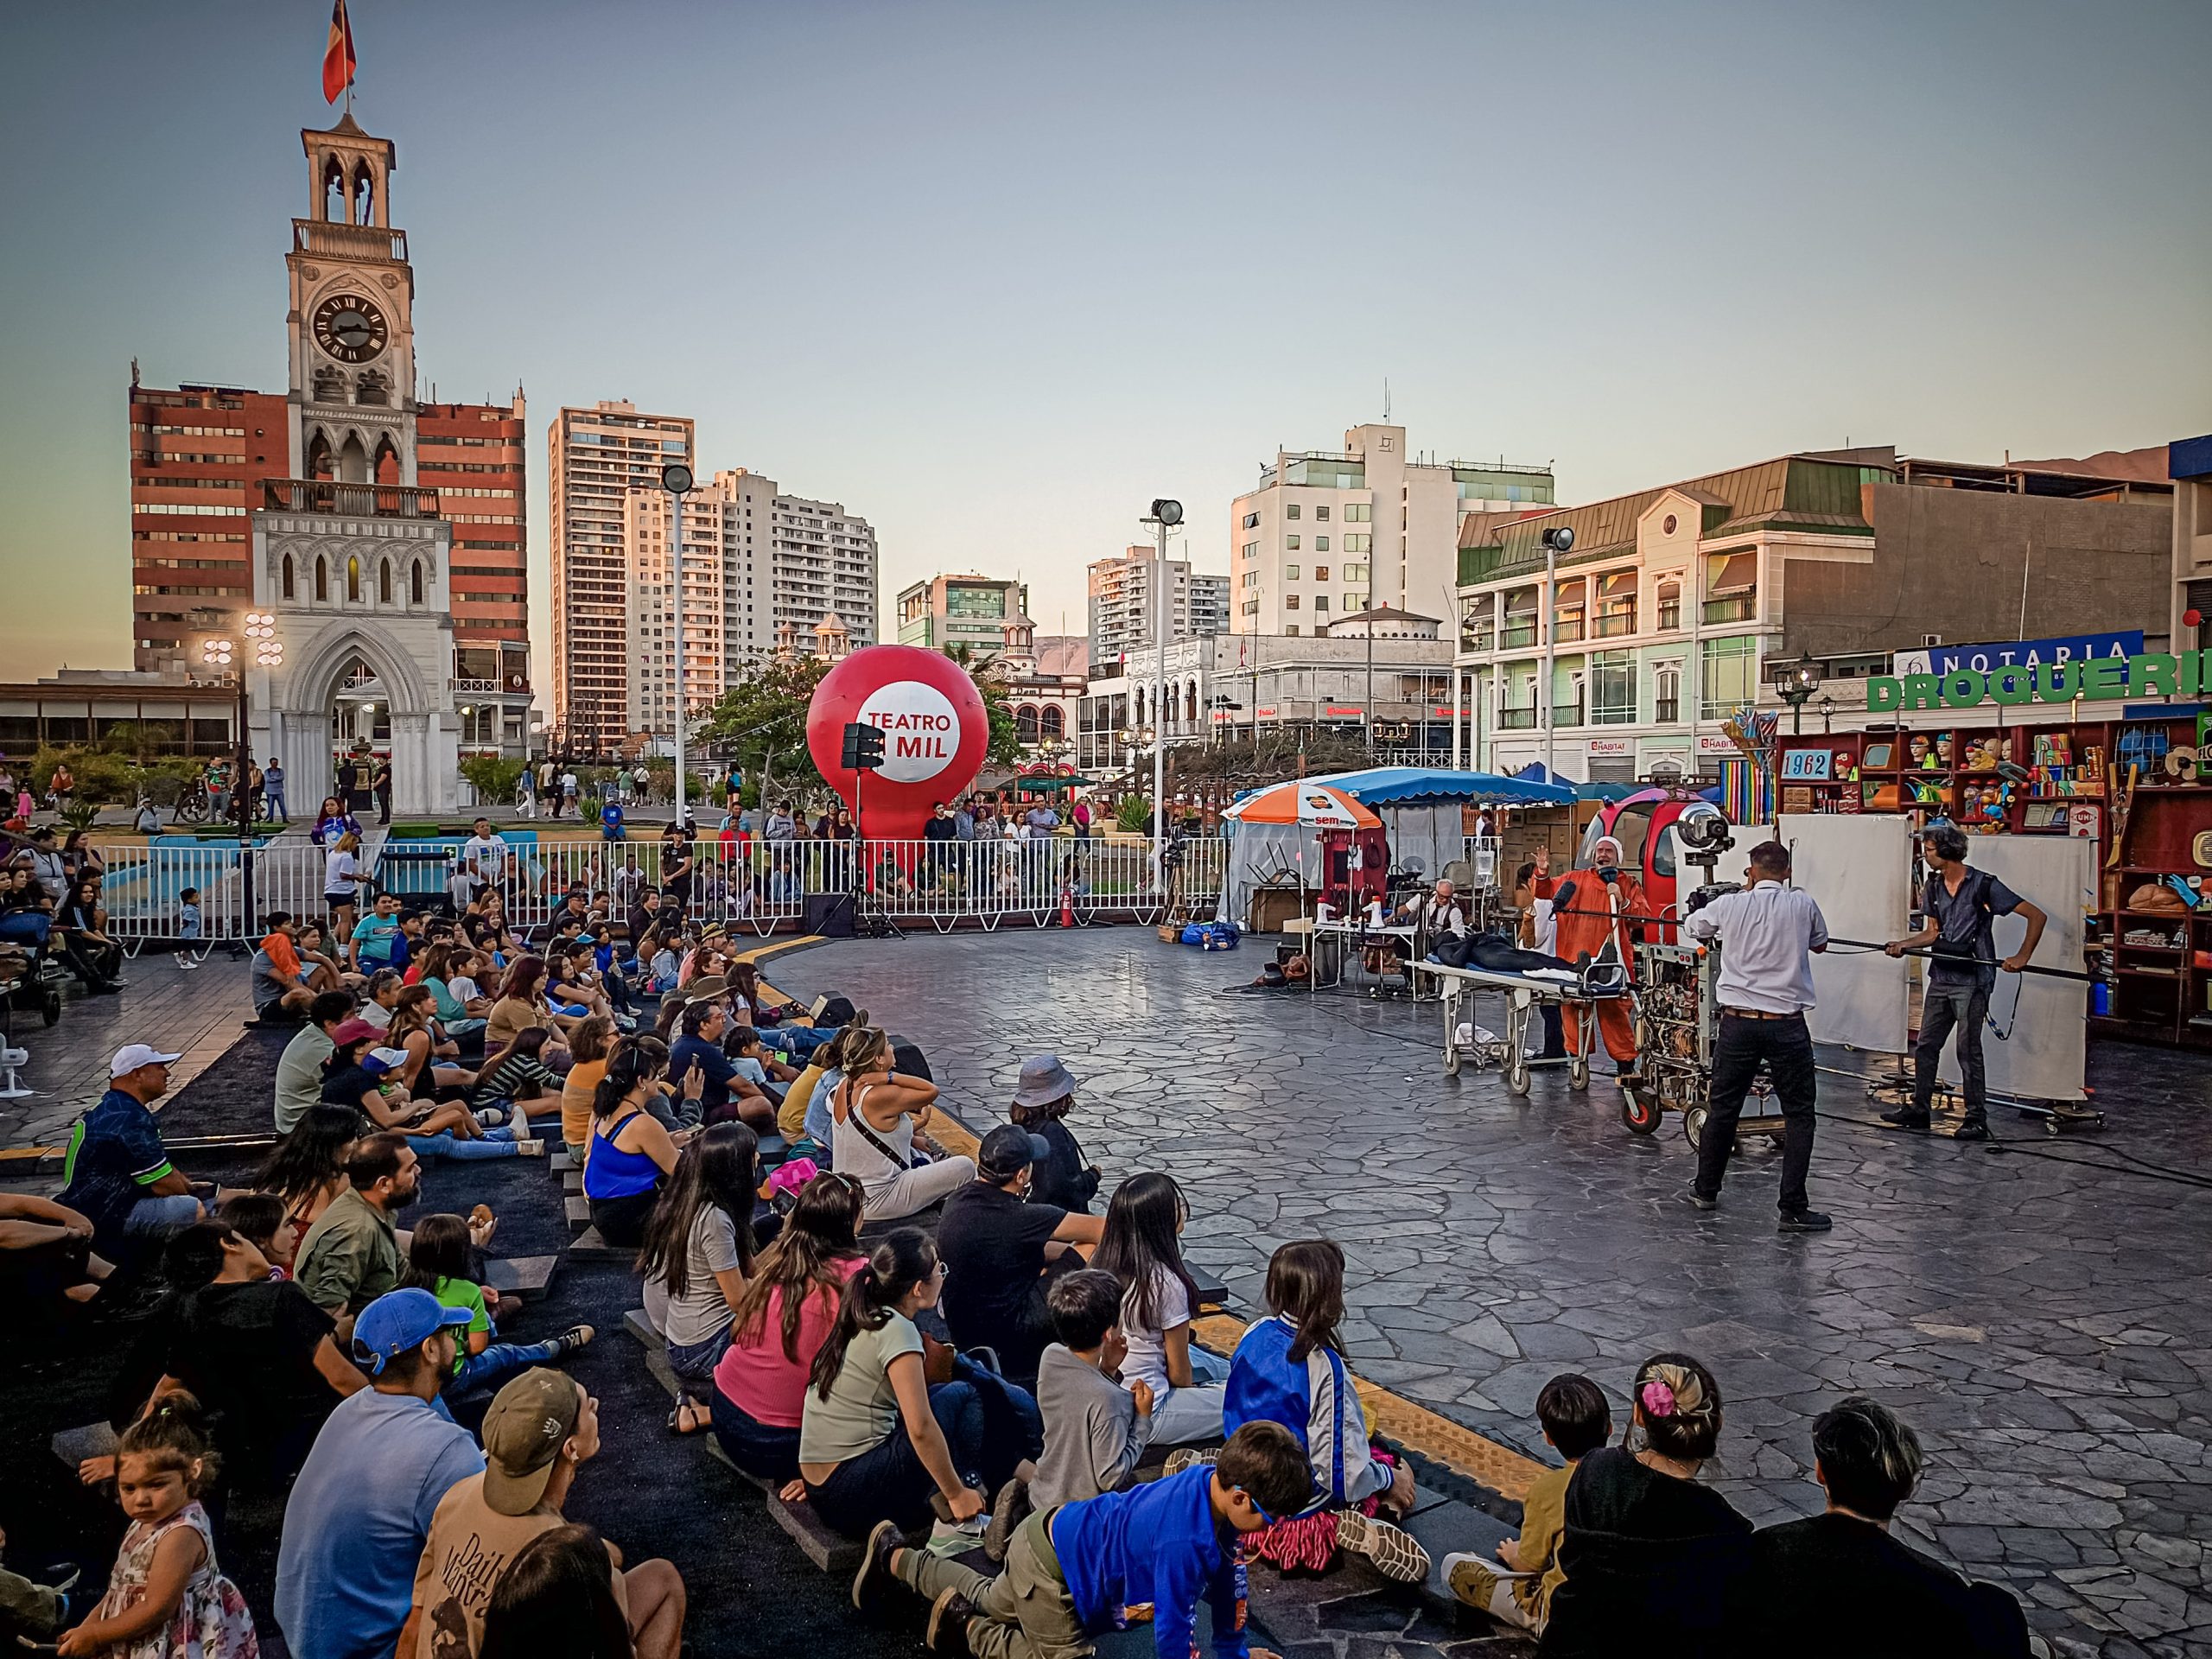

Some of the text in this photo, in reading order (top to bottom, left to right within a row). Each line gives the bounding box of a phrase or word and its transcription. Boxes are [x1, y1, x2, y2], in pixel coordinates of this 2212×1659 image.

[1943, 641, 2130, 677] NOTARIA
[868, 712, 950, 731] TEATRO
[897, 736, 948, 758] MIL
[1783, 754, 1827, 775] 1962
[1315, 817, 1339, 825] sem
